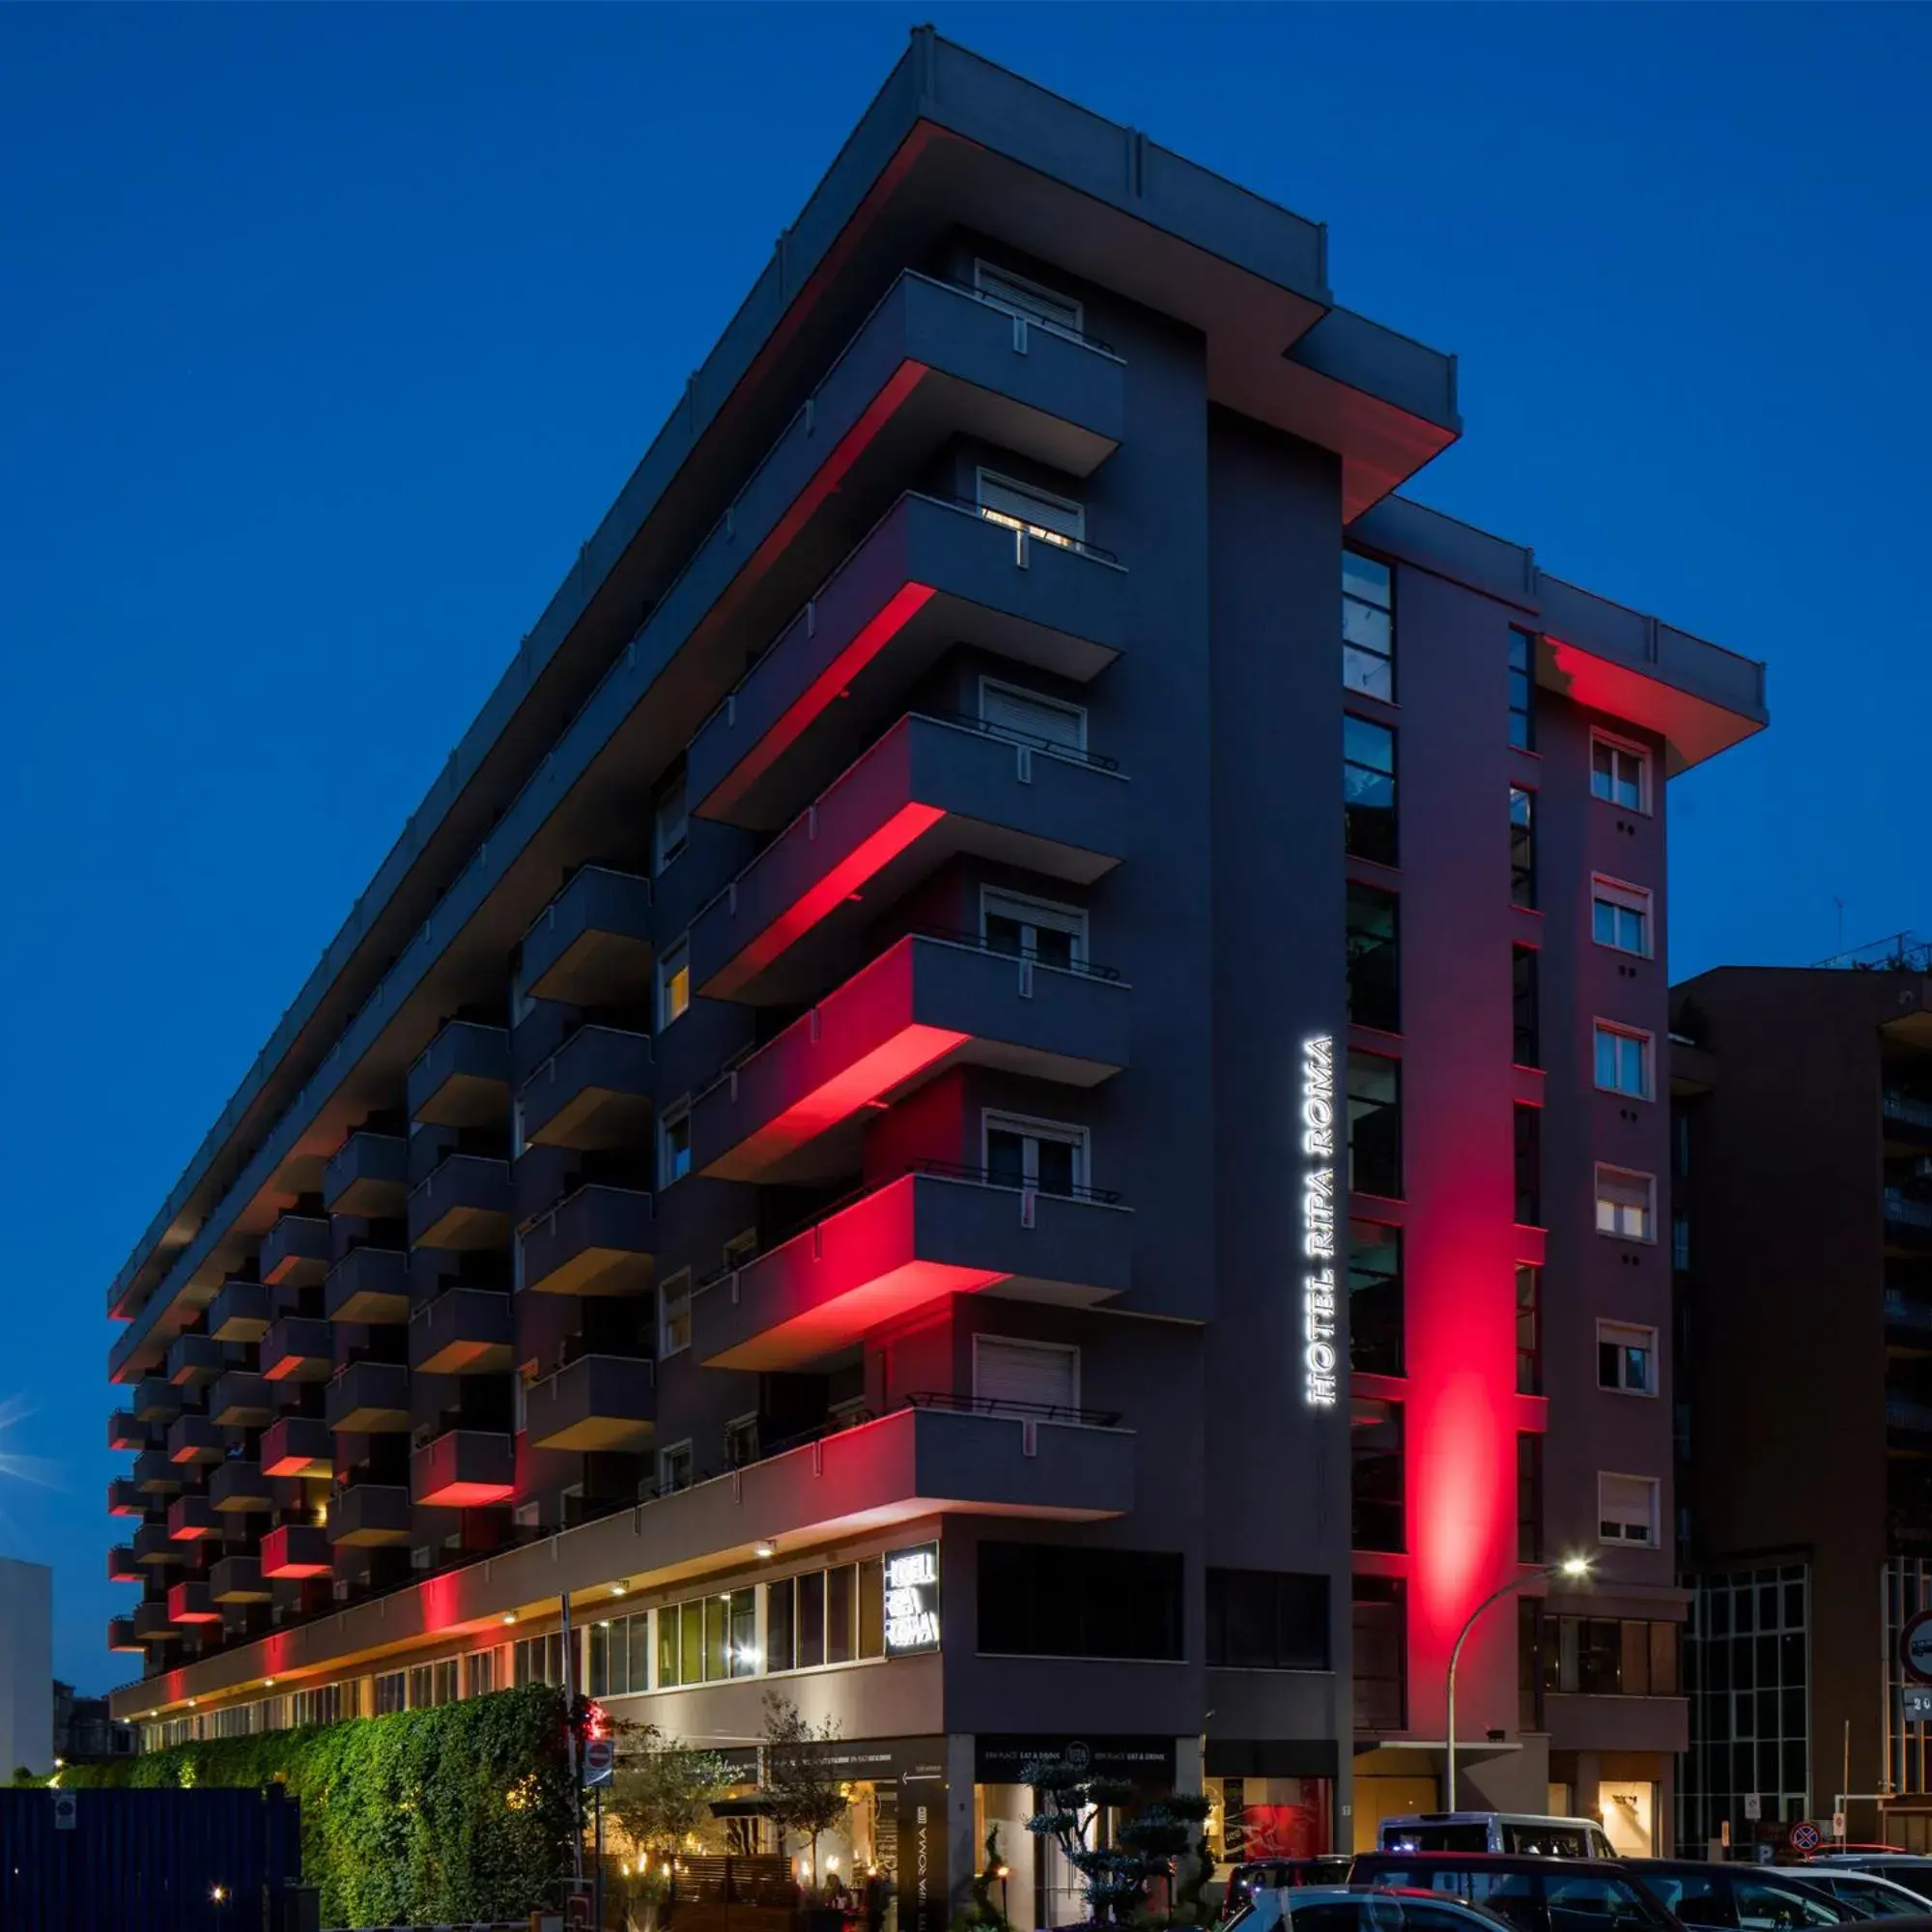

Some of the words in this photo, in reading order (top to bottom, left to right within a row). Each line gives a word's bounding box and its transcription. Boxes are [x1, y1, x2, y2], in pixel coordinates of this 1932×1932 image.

[1304, 1035, 1334, 1155] ROMA
[1305, 1168, 1334, 1257] RIPA
[1306, 1268, 1336, 1405] HOTEL
[918, 1828, 927, 1876] ROMA
